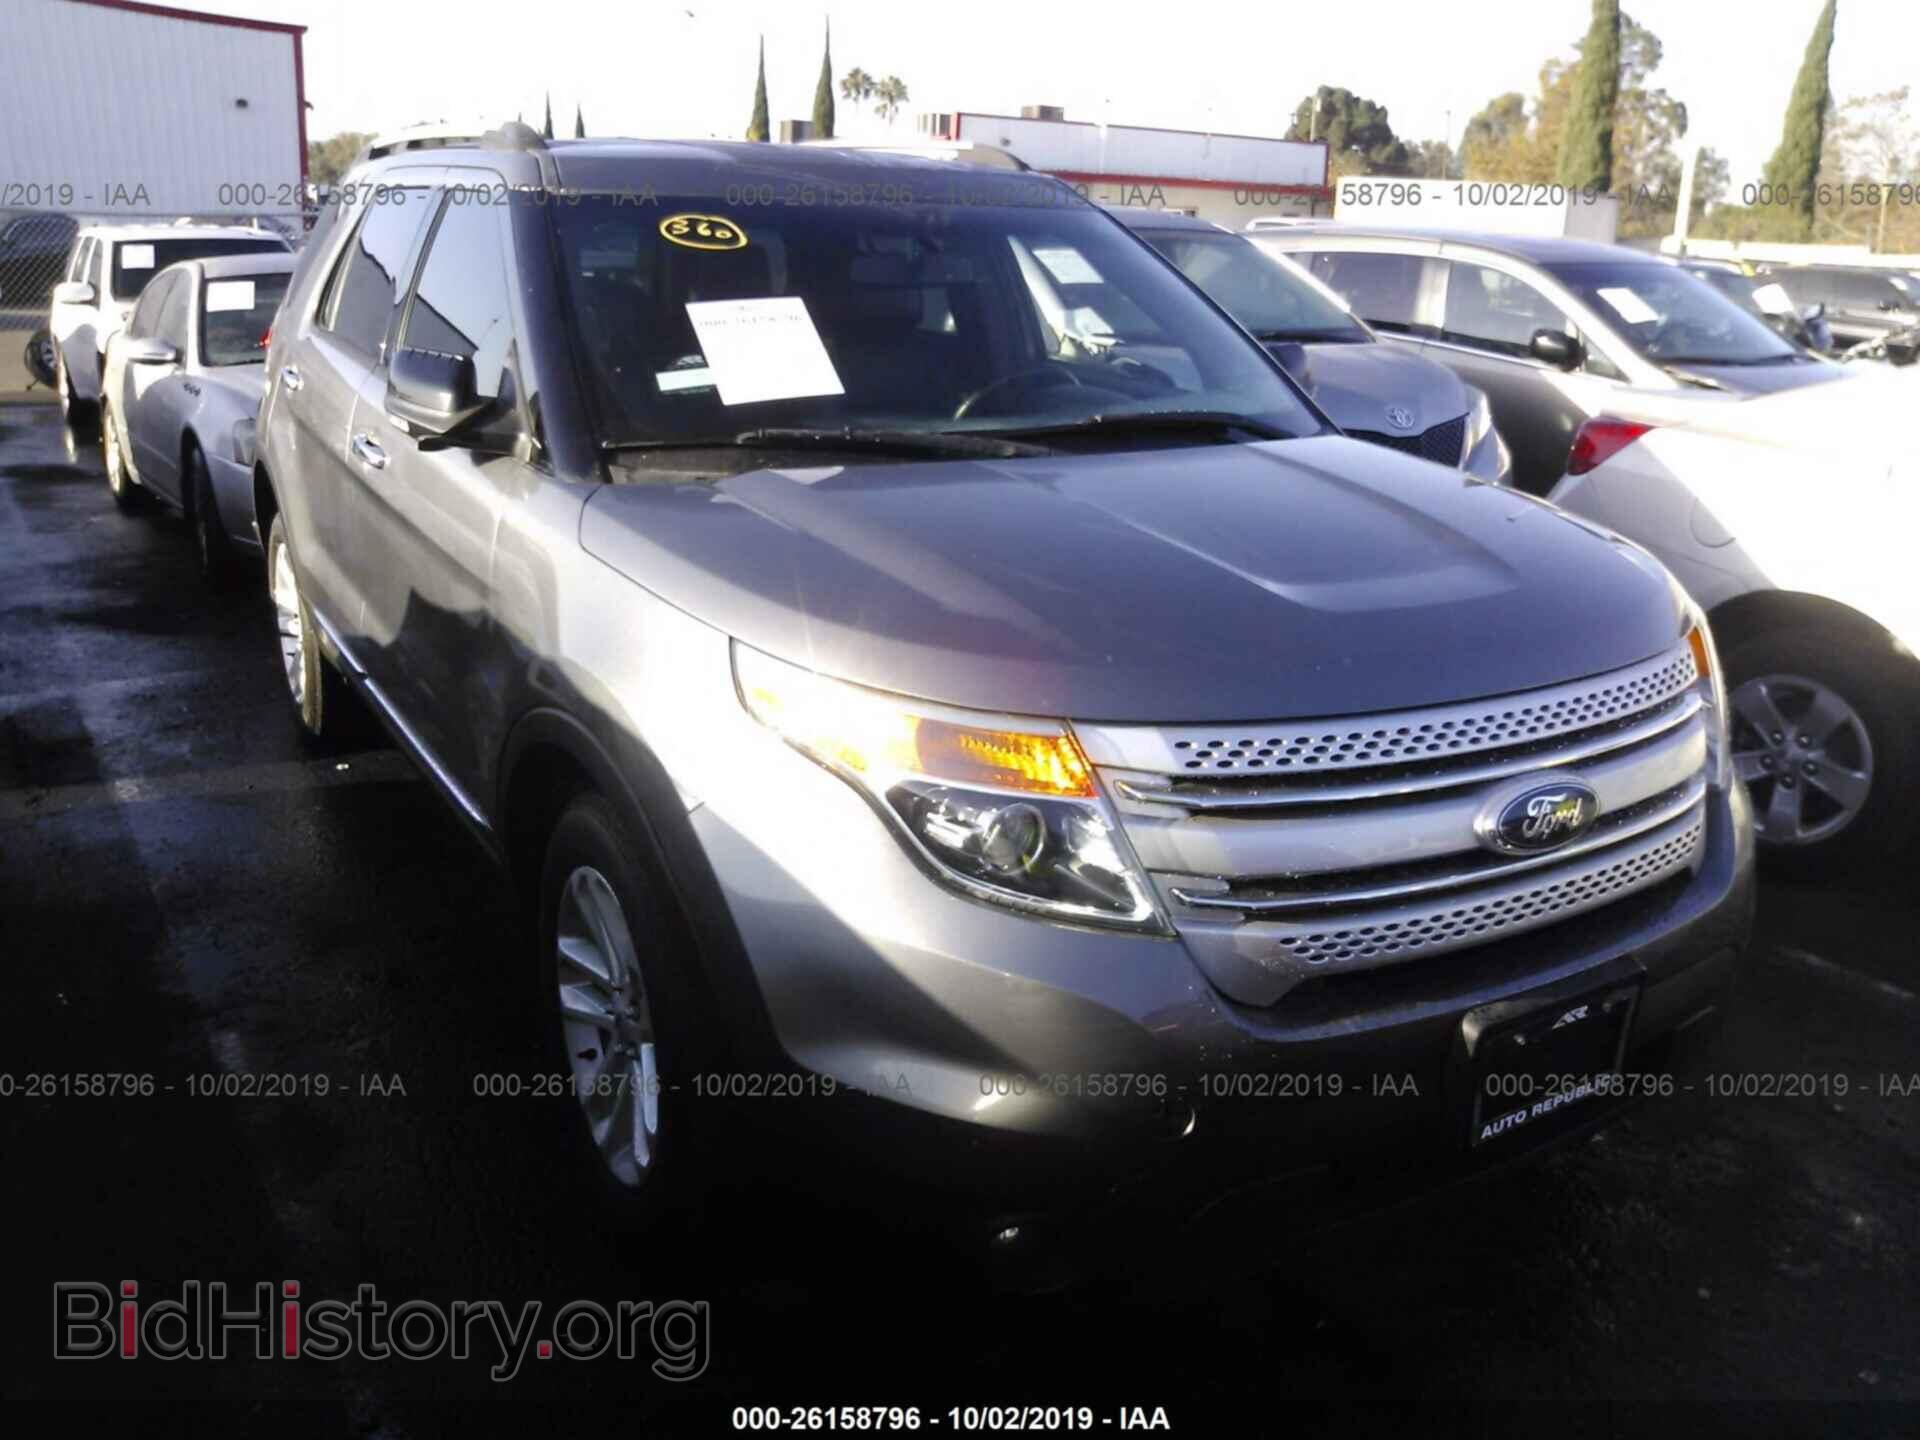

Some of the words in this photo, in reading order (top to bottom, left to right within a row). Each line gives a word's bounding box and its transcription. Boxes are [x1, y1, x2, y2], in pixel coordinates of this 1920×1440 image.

[671, 218, 733, 240] 360
[1522, 792, 1584, 840] Ford
[1480, 1109, 1527, 1140] AUTO
[1531, 1074, 1612, 1117] REPUBLIC
